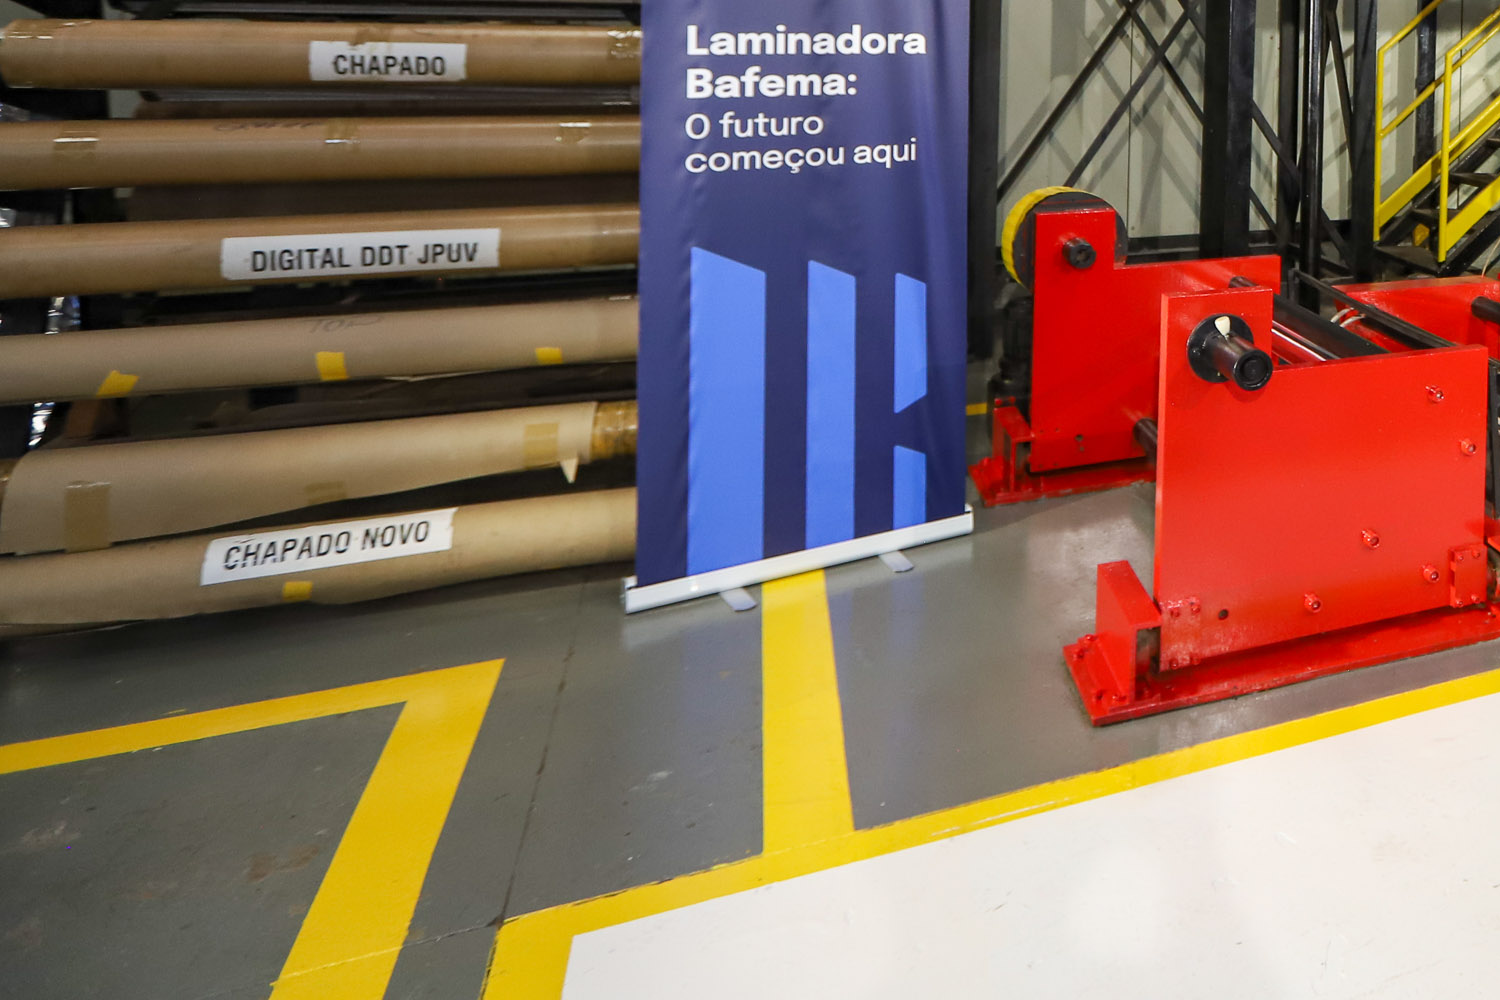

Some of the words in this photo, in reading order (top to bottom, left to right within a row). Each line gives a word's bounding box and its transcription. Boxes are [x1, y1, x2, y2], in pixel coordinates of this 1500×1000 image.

[686, 23, 927, 56] Laminadora
[332, 53, 446, 77] CHAPADO
[686, 65, 857, 99] Bafema:
[685, 113, 711, 140] O
[719, 111, 824, 138] futuro
[685, 146, 845, 174] começou
[853, 137, 917, 169] aqui
[250, 246, 351, 274] DIGITAL
[361, 244, 409, 268] DDT
[417, 242, 479, 265] JPUV
[223, 532, 351, 572] CHAPADO
[361, 520, 431, 550] NOVO
